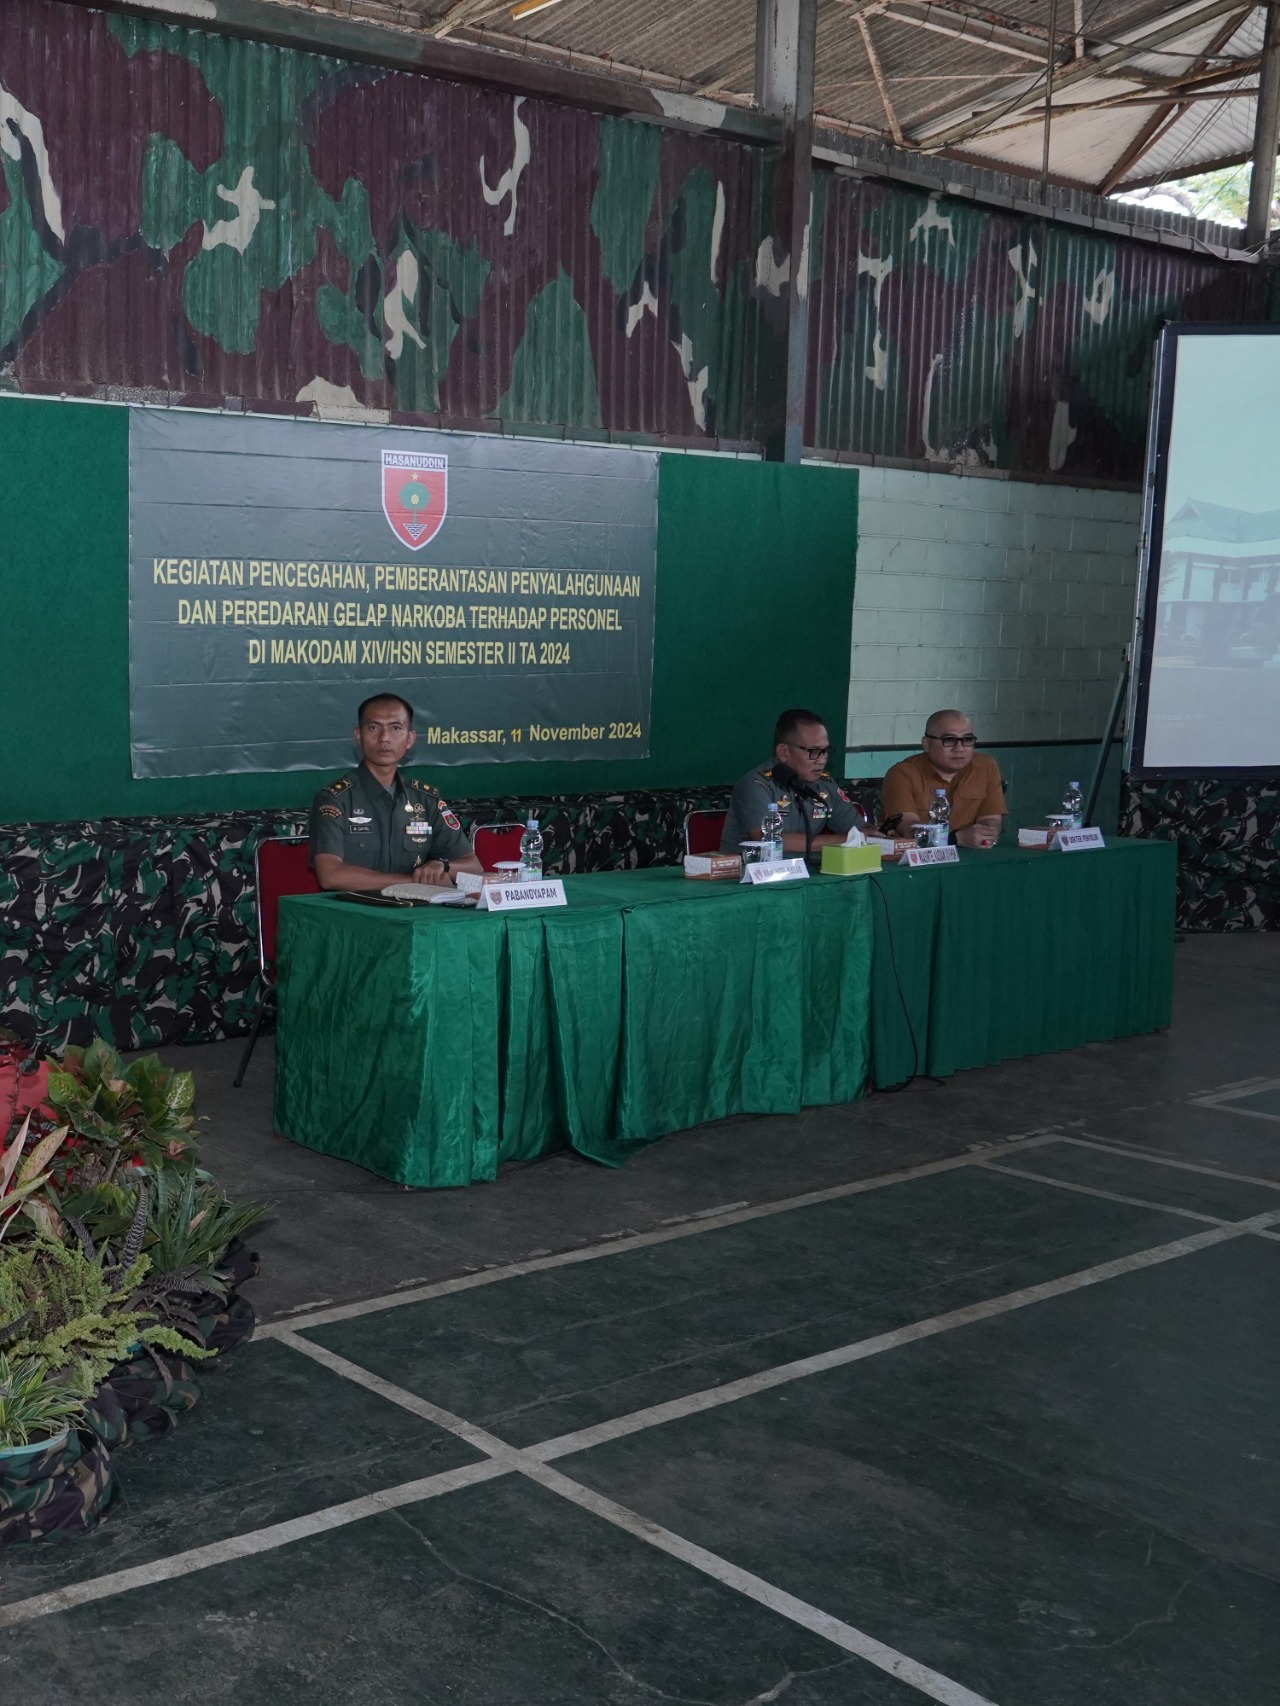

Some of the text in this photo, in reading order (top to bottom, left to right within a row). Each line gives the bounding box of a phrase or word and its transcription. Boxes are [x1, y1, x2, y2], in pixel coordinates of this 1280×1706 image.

[385, 454, 444, 469] HASANUDDIN
[153, 558, 641, 597] KEGIATAN PENCEGAHAN, PEMBERANTASAN PENYALAHGUNAAN
[178, 599, 623, 631] DAN PEREDARAN GELAP NARKOBA TERHADAP PERSONEL
[249, 639, 570, 665] DI MAKODAM XIV/HSN SEMESTER II TA 2024
[427, 722, 642, 745] Makassar, 11 November 2024
